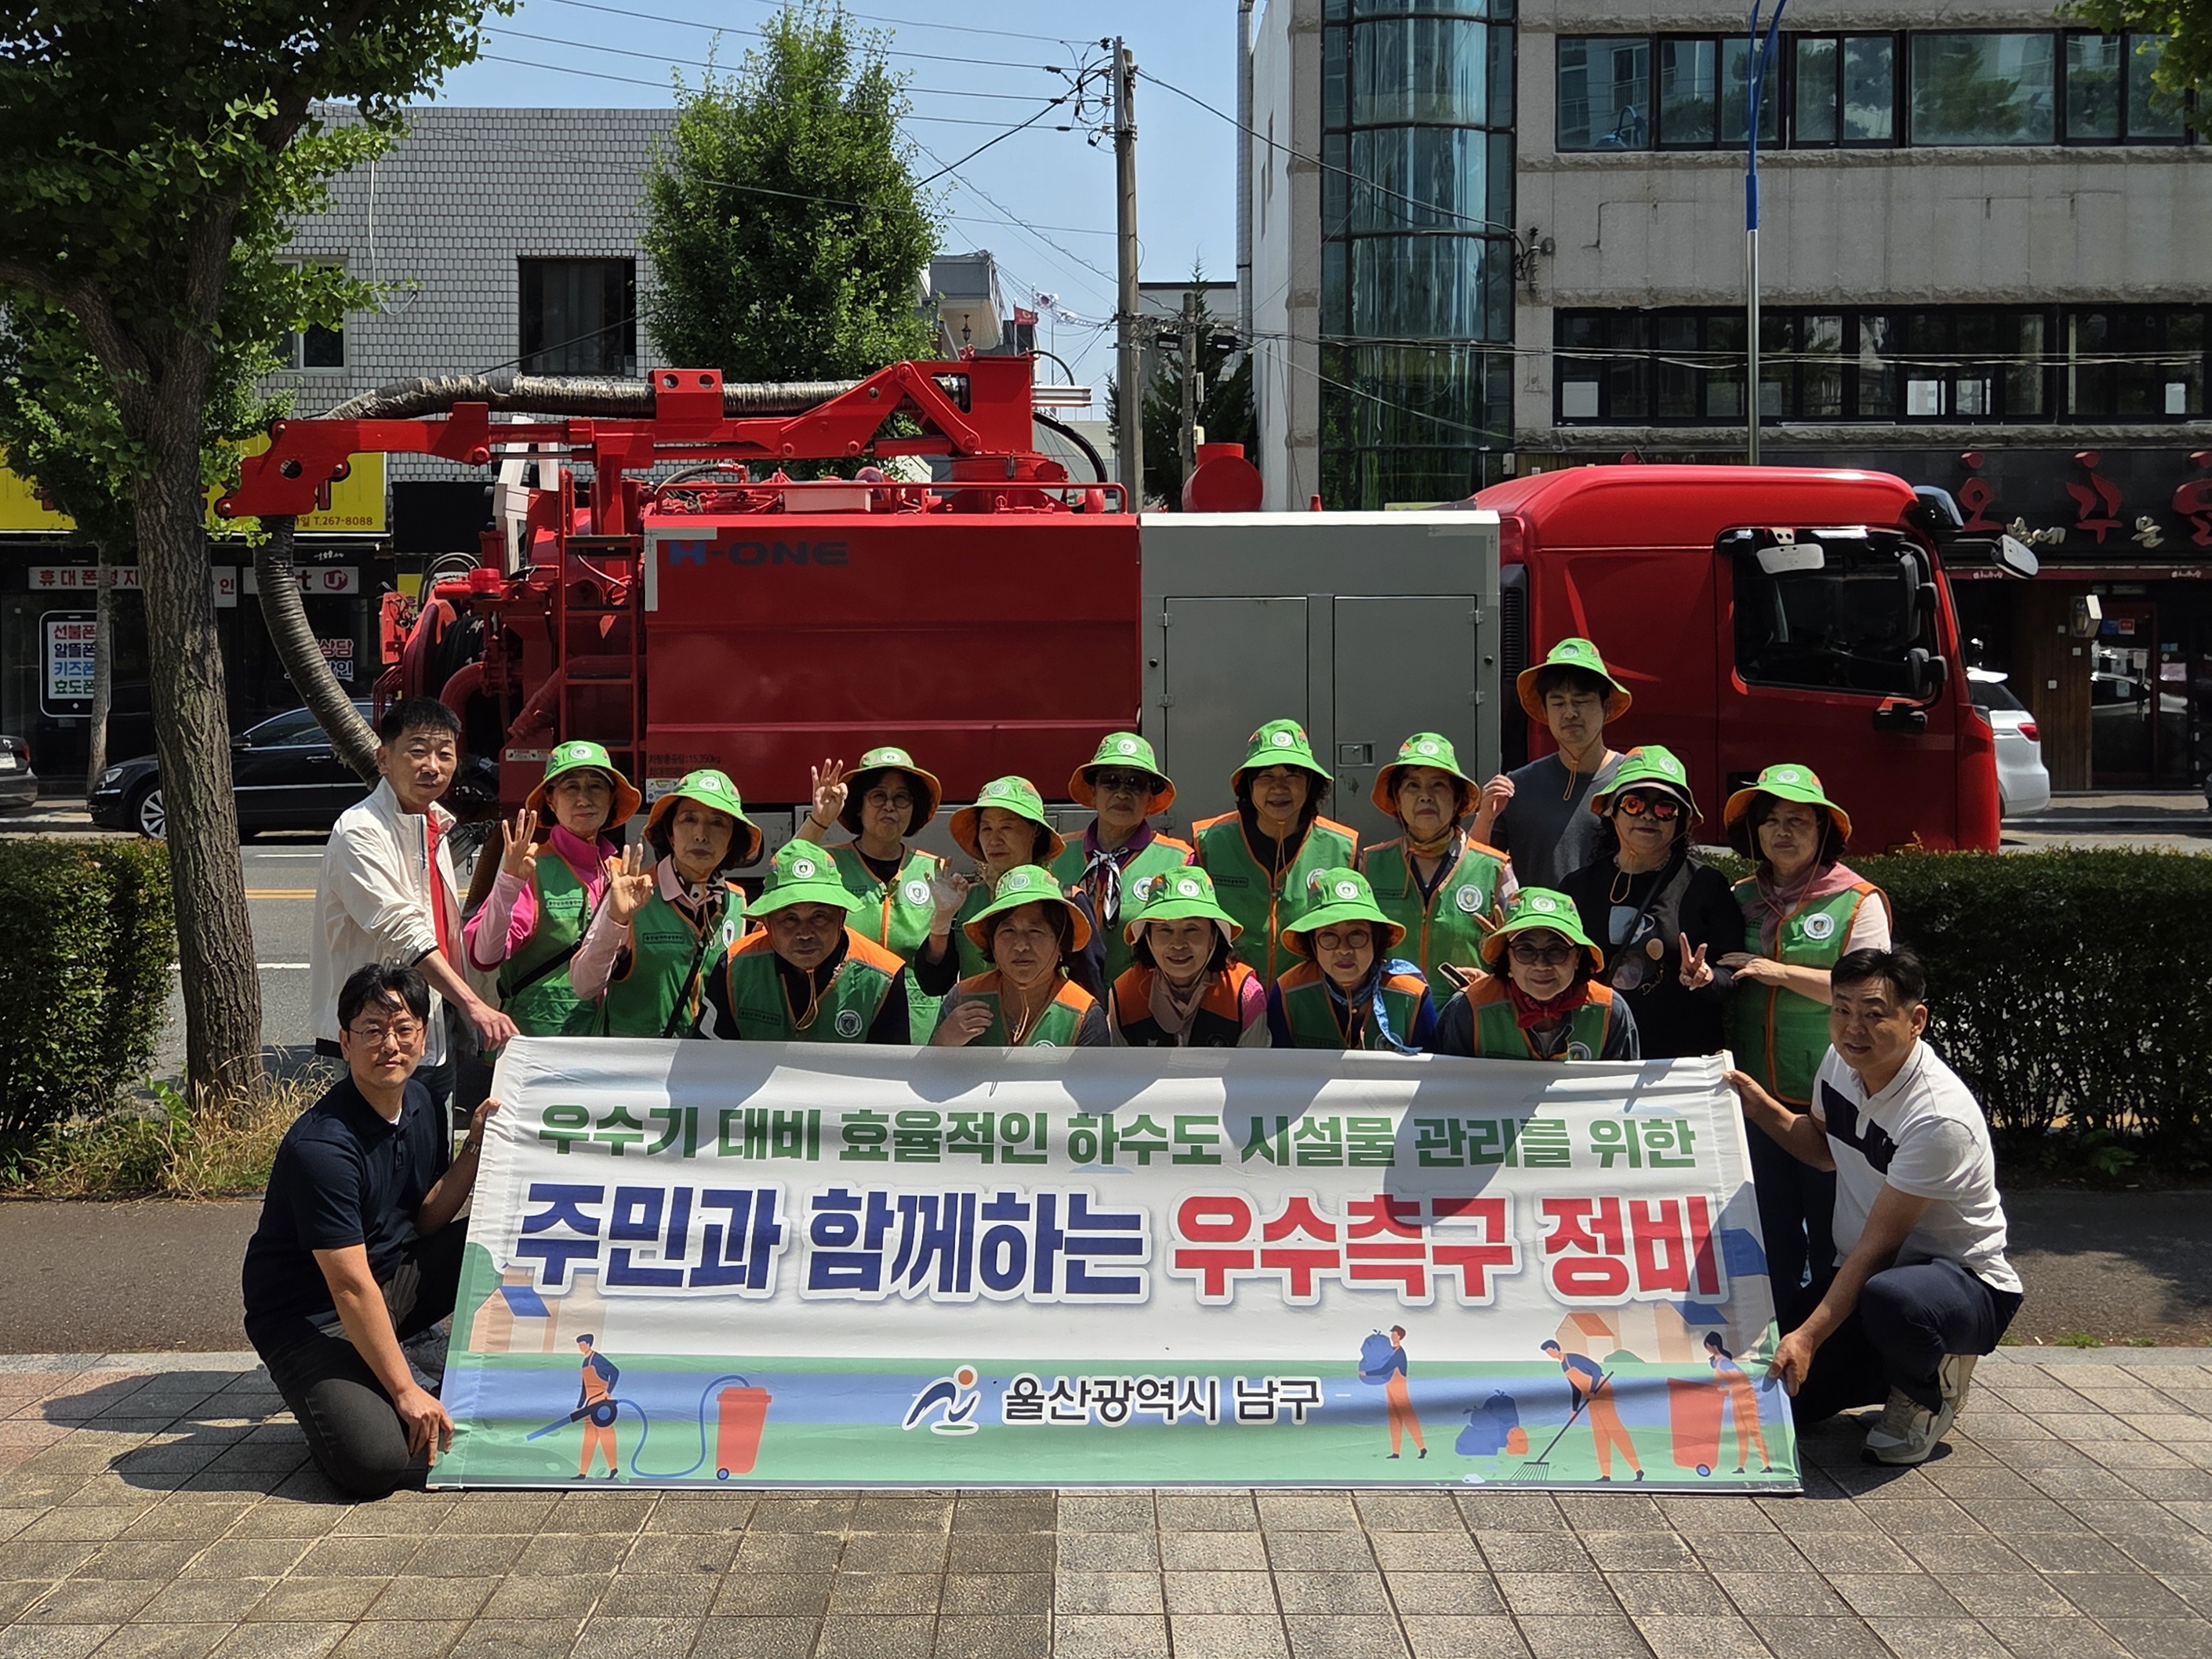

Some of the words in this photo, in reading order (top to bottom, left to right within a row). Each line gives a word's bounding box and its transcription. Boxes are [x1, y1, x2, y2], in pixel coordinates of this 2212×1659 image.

[314, 516, 373, 527] T.267-8088
[668, 540, 849, 567] H-ONE
[54, 661, 95, 677] 키즈폰
[54, 679, 95, 695] 효도폰
[539, 1105, 699, 1158] 우수기
[717, 1108, 821, 1160] 대비
[839, 1109, 1048, 1164] 효율적인
[1067, 1112, 1222, 1166] 하수도
[1241, 1116, 1396, 1167] 시설물
[1413, 1118, 1571, 1168] 관리를
[1589, 1118, 1697, 1169] 위한
[514, 1182, 783, 1290] 주민과
[807, 1188, 1143, 1295] 함께하는
[1174, 1193, 1513, 1298] 우수측구
[1541, 1196, 1721, 1297] 정비
[1005, 1377, 1218, 1423] 울산광역시
[1234, 1379, 1320, 1421] 남구
